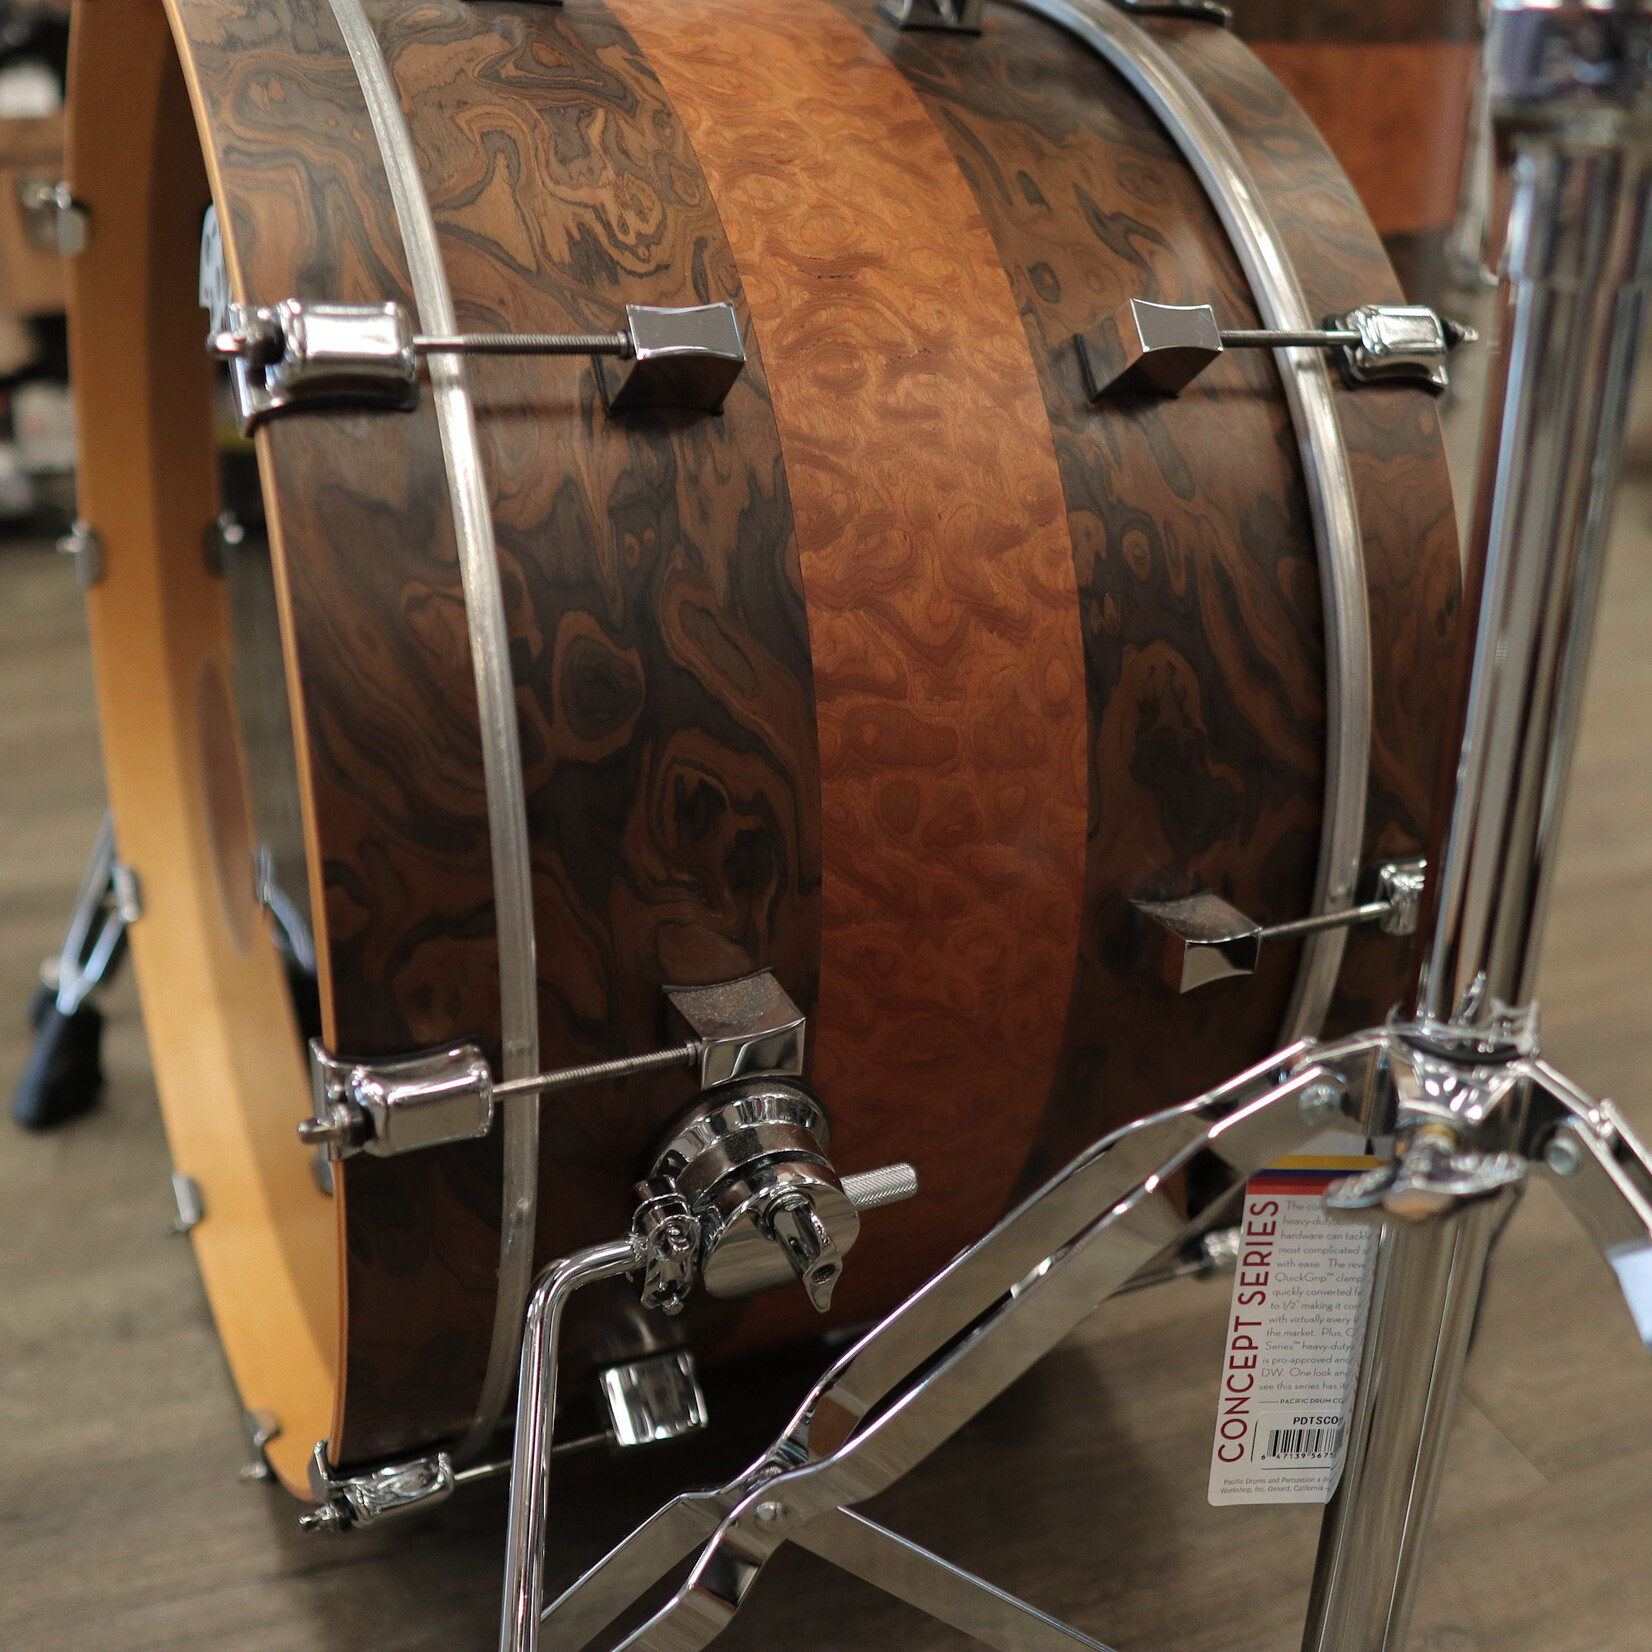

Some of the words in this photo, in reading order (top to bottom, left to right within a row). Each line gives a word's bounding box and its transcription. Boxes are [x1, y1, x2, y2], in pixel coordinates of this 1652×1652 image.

[1287, 1200, 1304, 1211] The
[1281, 1230, 1324, 1240] hardware
[1238, 1201, 1279, 1306] SERIES
[1279, 1246, 1301, 1254] most
[1303, 1244, 1360, 1256] complicated
[1277, 1258, 1296, 1268] with
[1328, 1258, 1346, 1268] The
[1272, 1286, 1303, 1298] quickly
[1306, 1287, 1352, 1297] converted
[1271, 1302, 1280, 1310] to
[1301, 1301, 1333, 1312] making
[1335, 1301, 1341, 1310] it
[1268, 1314, 1288, 1324] with
[1290, 1314, 1323, 1326] virtually
[1326, 1316, 1352, 1326] every
[1267, 1328, 1281, 1337] the
[1302, 1340, 1351, 1353] heavy-duty
[1262, 1356, 1269, 1364] is
[1271, 1354, 1333, 1366] pro-approved
[1289, 1367, 1312, 1377] One
[1314, 1367, 1332, 1377] look
[1218, 1315, 1262, 1463] CONCEPT
[1259, 1383, 1275, 1391] see
[1276, 1381, 1293, 1390] this
[1322, 1381, 1338, 1390] has
[1268, 1477, 1280, 1485] and
[1282, 1476, 1315, 1484] Percussion
[1293, 1485, 1323, 1493] California
